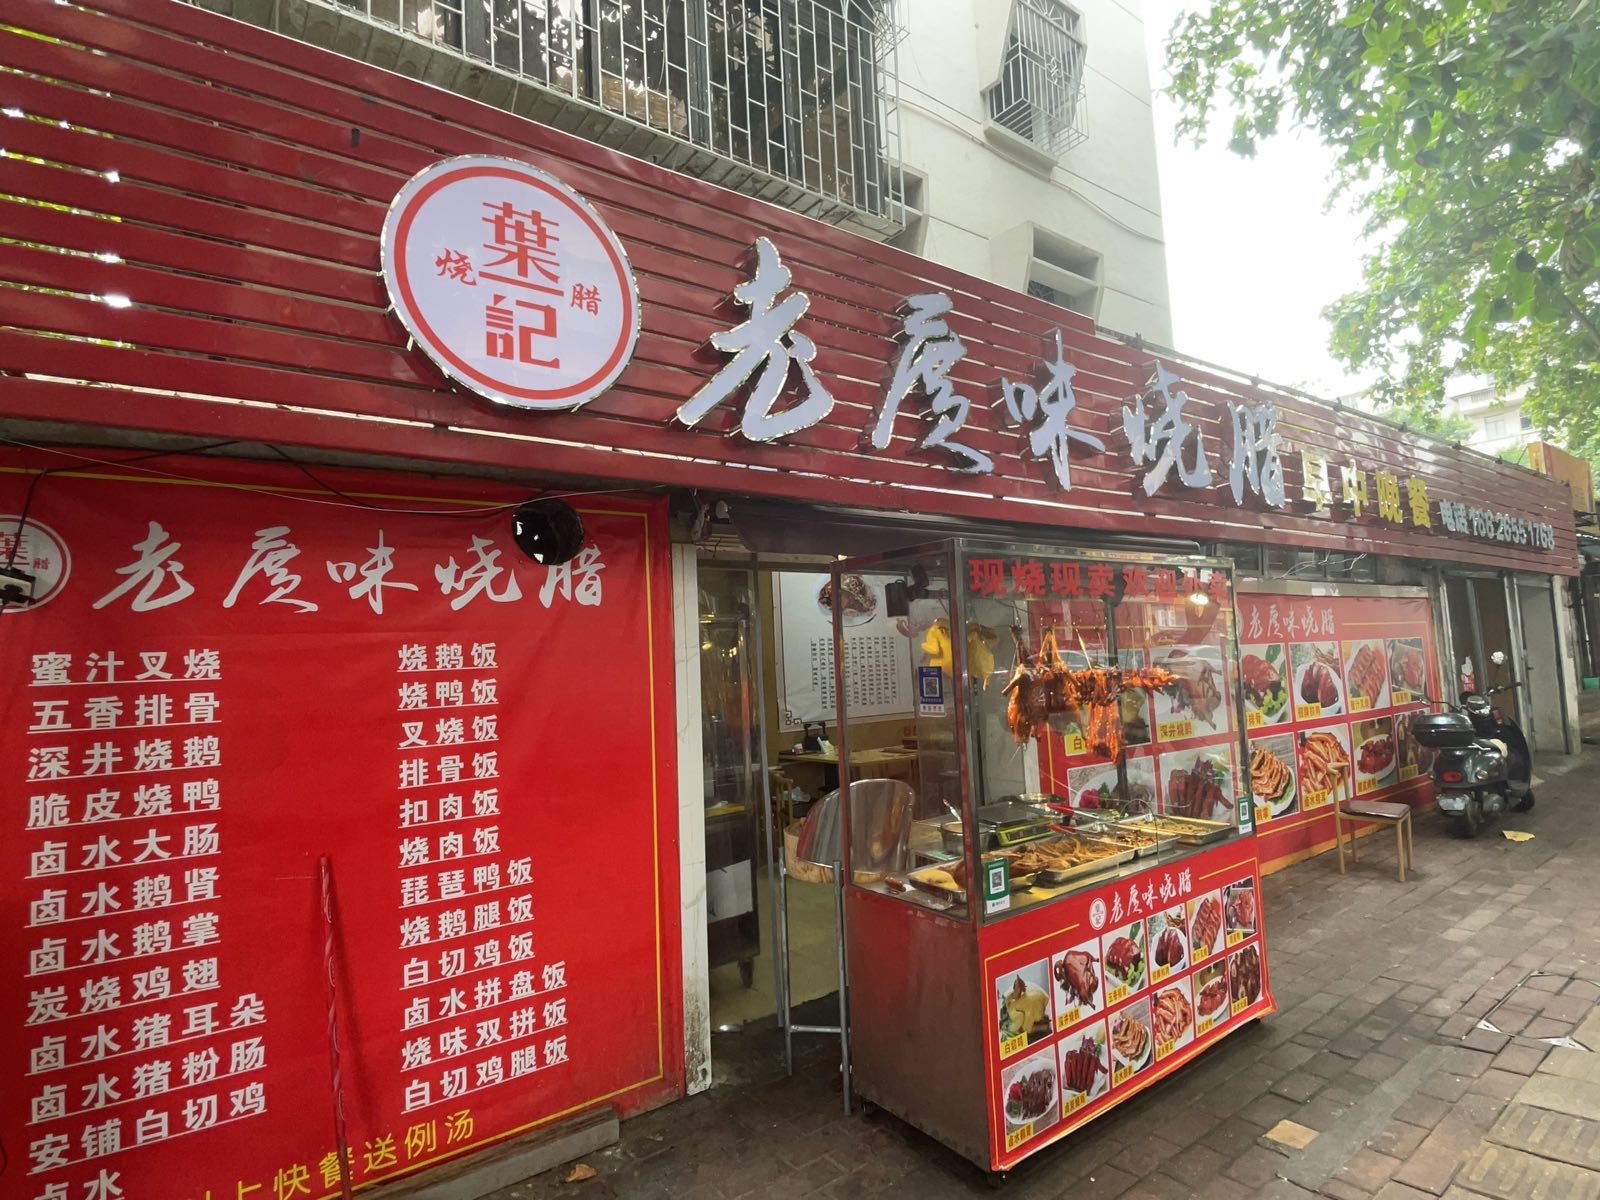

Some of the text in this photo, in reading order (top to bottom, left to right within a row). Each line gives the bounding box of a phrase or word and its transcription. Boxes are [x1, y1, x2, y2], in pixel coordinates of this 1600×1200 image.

[435, 248, 602, 316] 烧 腊
[479, 201, 564, 370] 葉記
[31, 648, 221, 685] 蜜汁叉烧
[398, 642, 497, 671] 烧鹅饭
[29, 692, 220, 731] 五香排骨
[398, 678, 498, 709] 烧鸭饭
[28, 735, 220, 780] 深井烧鹅
[399, 714, 498, 747] 叉烧饭
[398, 750, 499, 787] 排骨饭
[27, 778, 220, 827] 脆皮烧鸭
[398, 788, 499, 827] 扣肉饭
[31, 823, 220, 877] 卤水大肠
[400, 825, 499, 866] 烧肉饭
[30, 866, 220, 927] 卤水鹅肾
[401, 857, 533, 907] 琵琶鸭饭
[30, 912, 220, 976] 卤水鹅掌
[400, 894, 533, 947] 烧鹅腿饭
[403, 931, 534, 988] 白切鸡饭
[27, 957, 219, 1025] 炭烧鸡翅
[404, 961, 566, 1030] 卤水拼盘饭
[30, 992, 265, 1074] 卤水猪耳朵
[402, 998, 567, 1071] 烧味双拼饭
[31, 1036, 265, 1124] 卤水猪粉肠
[404, 1035, 568, 1111] 白切鸡腿饭
[29, 1082, 265, 1171] 安铺白切鸡
